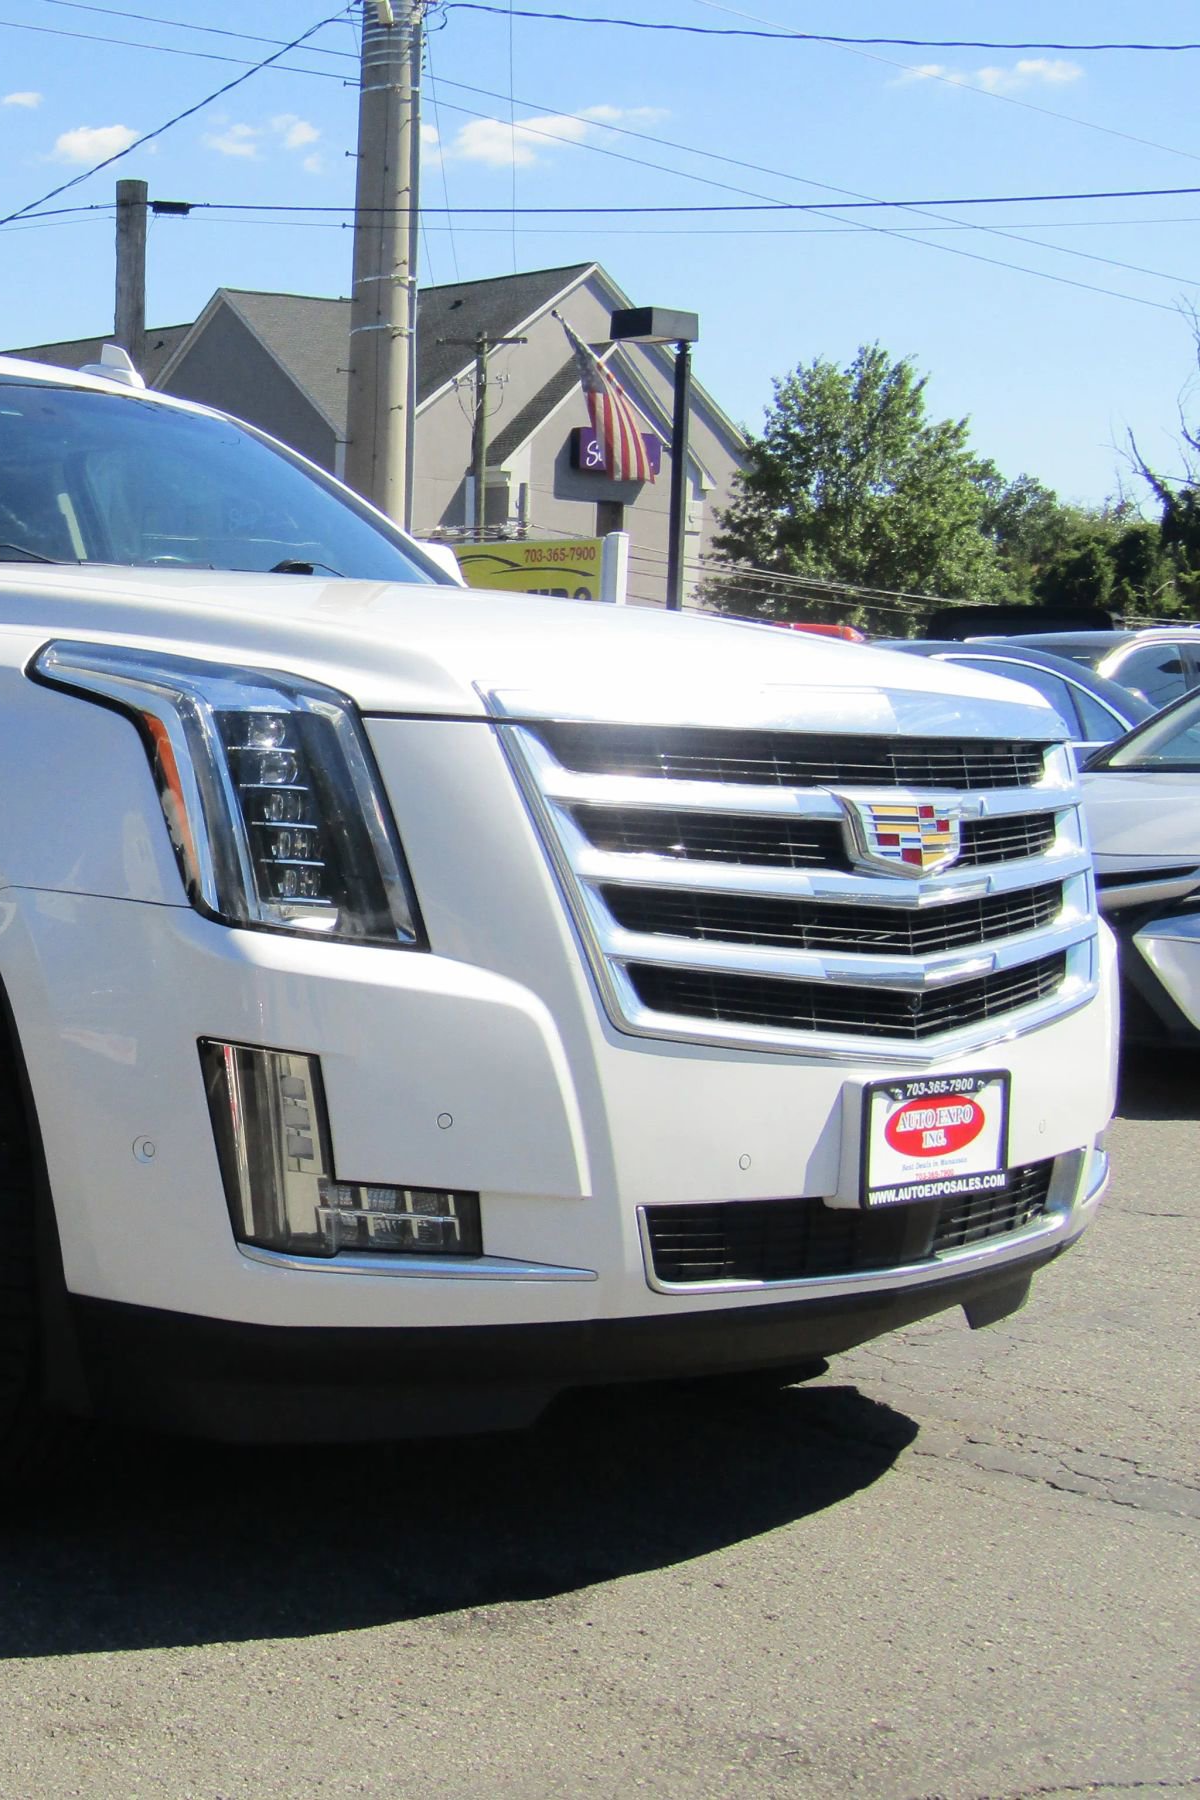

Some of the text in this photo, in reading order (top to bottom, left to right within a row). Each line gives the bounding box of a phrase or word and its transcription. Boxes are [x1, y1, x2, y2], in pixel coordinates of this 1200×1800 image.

[524, 547, 596, 563] 703-365-7900
[906, 1077, 974, 1097] 703-365-7900
[896, 1105, 974, 1132] AUTO EXPO
[922, 1129, 947, 1149] INC.
[869, 1173, 1006, 1205] WWW.AUTOEXPOSALES.COM
